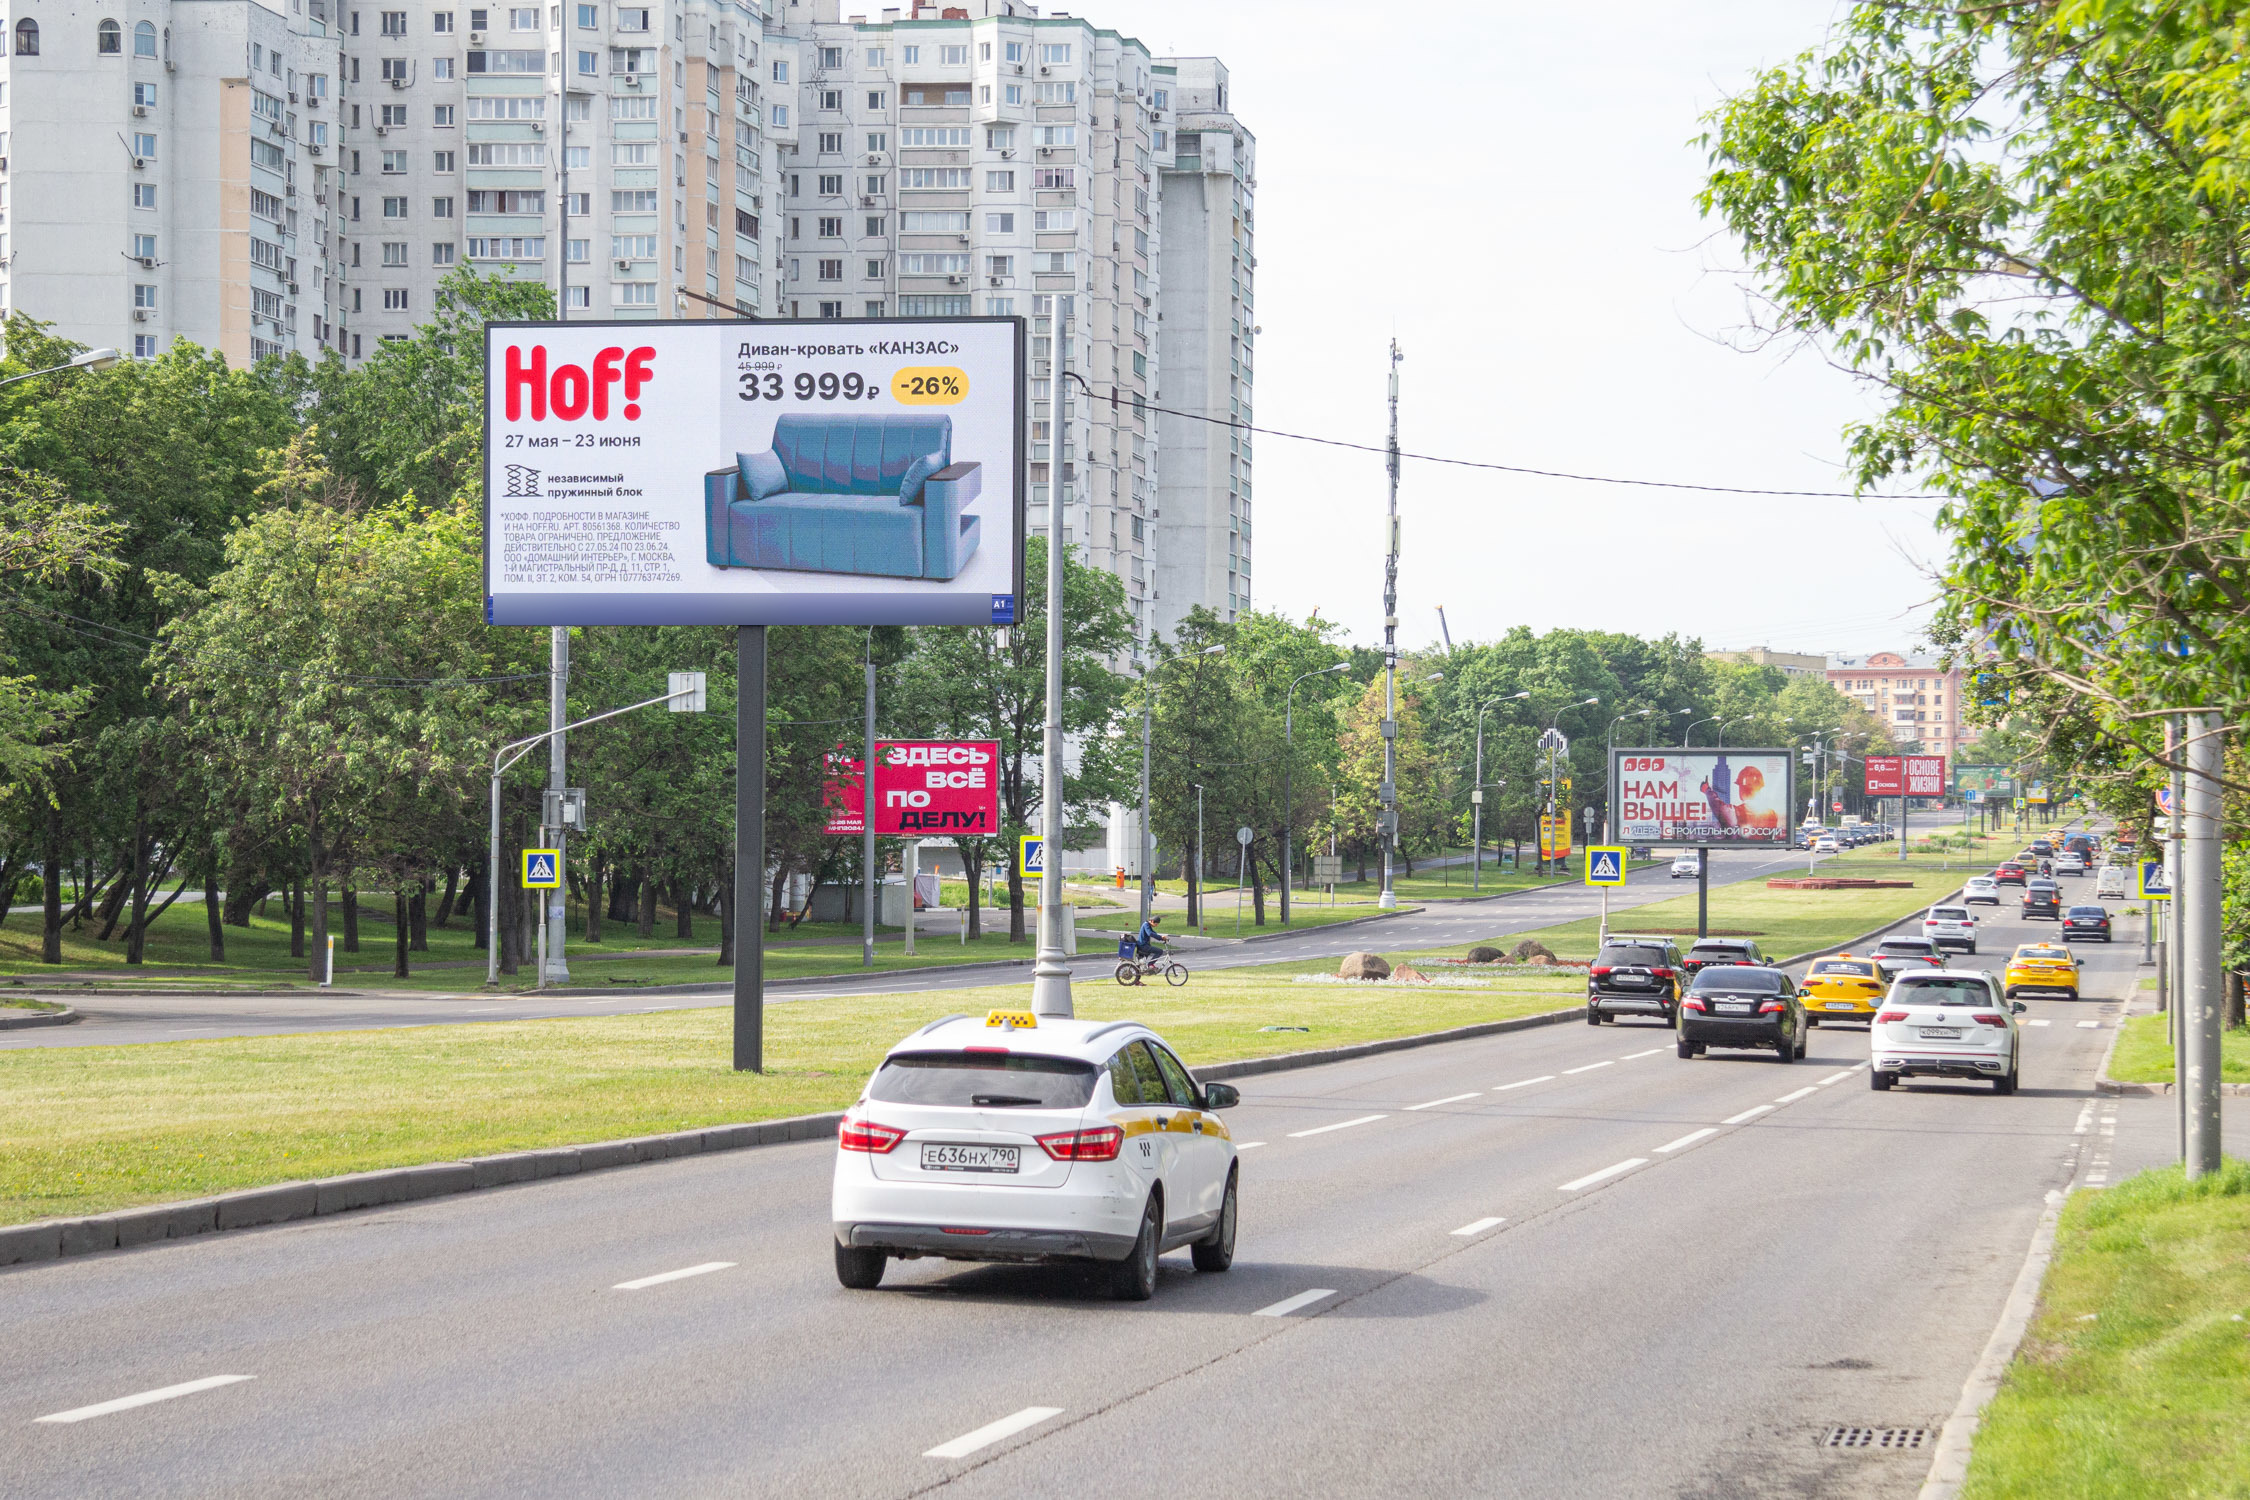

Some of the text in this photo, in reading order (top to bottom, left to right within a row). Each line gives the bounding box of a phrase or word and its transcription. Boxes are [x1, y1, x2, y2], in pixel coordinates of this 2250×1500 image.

[738, 341, 958, 358] Диван-кровать «КАНЗАС»
[738, 362, 751, 371] 45
[754, 362, 775, 370] 999
[738, 373, 784, 401] 33
[900, 376, 959, 395] -26%
[505, 435, 524, 447] 27
[528, 437, 558, 447] мая
[575, 434, 594, 447] 23
[600, 436, 641, 447] июня
[548, 473, 624, 483] независимый
[548, 487, 642, 499] пружинный блок
[533, 512, 596, 522] ПОДРОБНОСТИ
[598, 512, 603, 520] В
[606, 512, 649, 520] МАГАЗИНЕ
[504, 523, 510, 531] И
[512, 523, 524, 531] НА
[563, 522, 580, 531] АРТ.
[583, 522, 622, 531] 80561368.
[625, 522, 680, 530] КОЛИЧЕСТВО
[504, 532, 661, 542] ТОВАРА ОГРАНИЧЕНО. ПРЕДЛОЖЕНИЕ
[504, 542, 670, 553] ДЕЙСТВИТЕЛЬНО С 27.05.24 ПО 23.06.24.
[504, 552, 675, 563] ООО «ДОМАШНИЙ ИНТЕРЬЕР», Г. МОСКВА,
[504, 562, 517, 572] 1-Й
[519, 562, 594, 572] МАГИСТРАЛЬНЫЙ
[596, 563, 618, 572] ПР-Д,
[632, 563, 642, 572] 11,
[644, 563, 661, 571] СТР.
[663, 563, 670, 572] 1,
[504, 574, 525, 582] ПОМ.
[536, 574, 548, 582] ЭТ.
[550, 574, 556, 583] 2,
[558, 574, 579, 582] КОМ.
[582, 574, 593, 583] 54,
[595, 574, 616, 582] ОГРН
[619, 573, 682, 582] 1077763747269.
[886, 747, 989, 767] ЗДЕСЬ
[1874, 764, 1885, 772] 6,6
[1909, 760, 1940, 775] ОСНОВЕ
[926, 768, 986, 789] ВСЁ
[1909, 776, 1939, 792] ЖИЗНИ
[1624, 781, 1678, 799] НАМ
[887, 791, 930, 808] ПО
[1624, 802, 1707, 820] ВЫШЕ!
[899, 812, 986, 830] ДЕЛУ!
[1622, 826, 1660, 835] ЛИДЕРЫ
[1664, 826, 1740, 835] СТРОИТЕЛЬНОЙ
[928, 1148, 1015, 1165] Е636НХ 790
